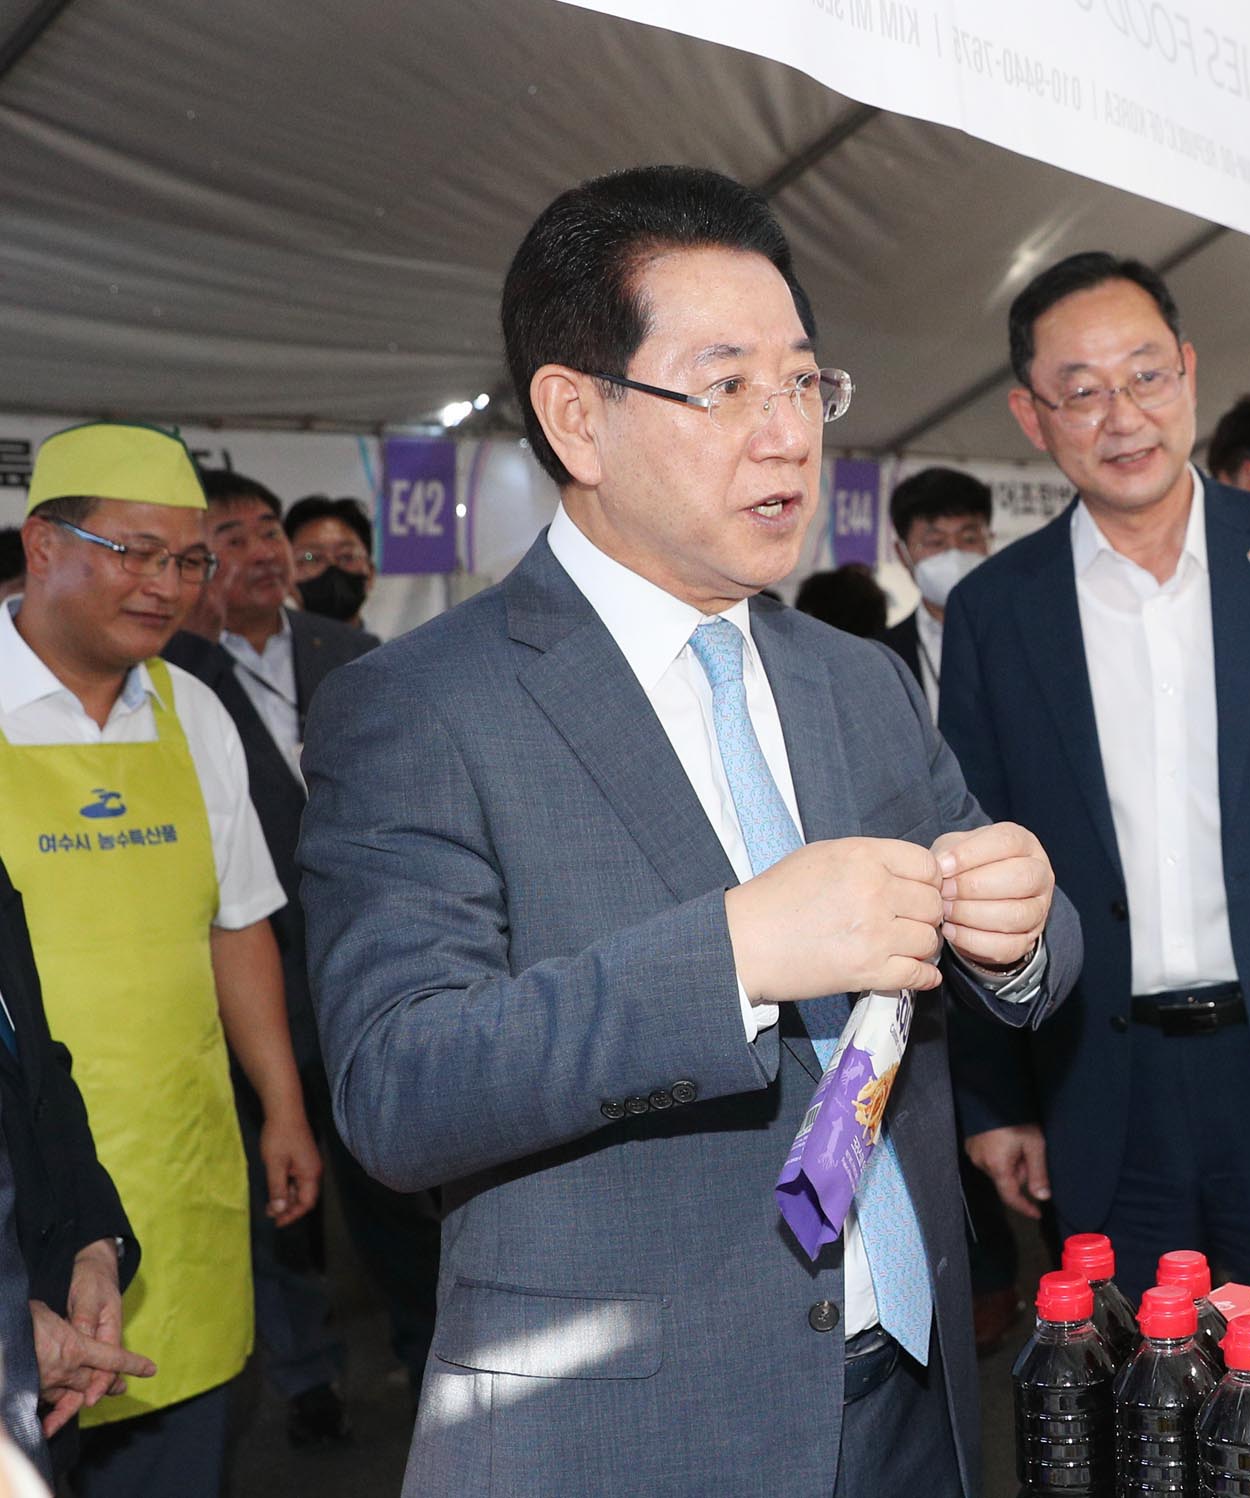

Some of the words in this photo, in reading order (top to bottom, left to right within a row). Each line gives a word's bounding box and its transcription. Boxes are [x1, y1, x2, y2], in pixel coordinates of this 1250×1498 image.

[390, 480, 445, 537] E42
[836, 490, 873, 536] E44
[38, 832, 92, 853] 여수시
